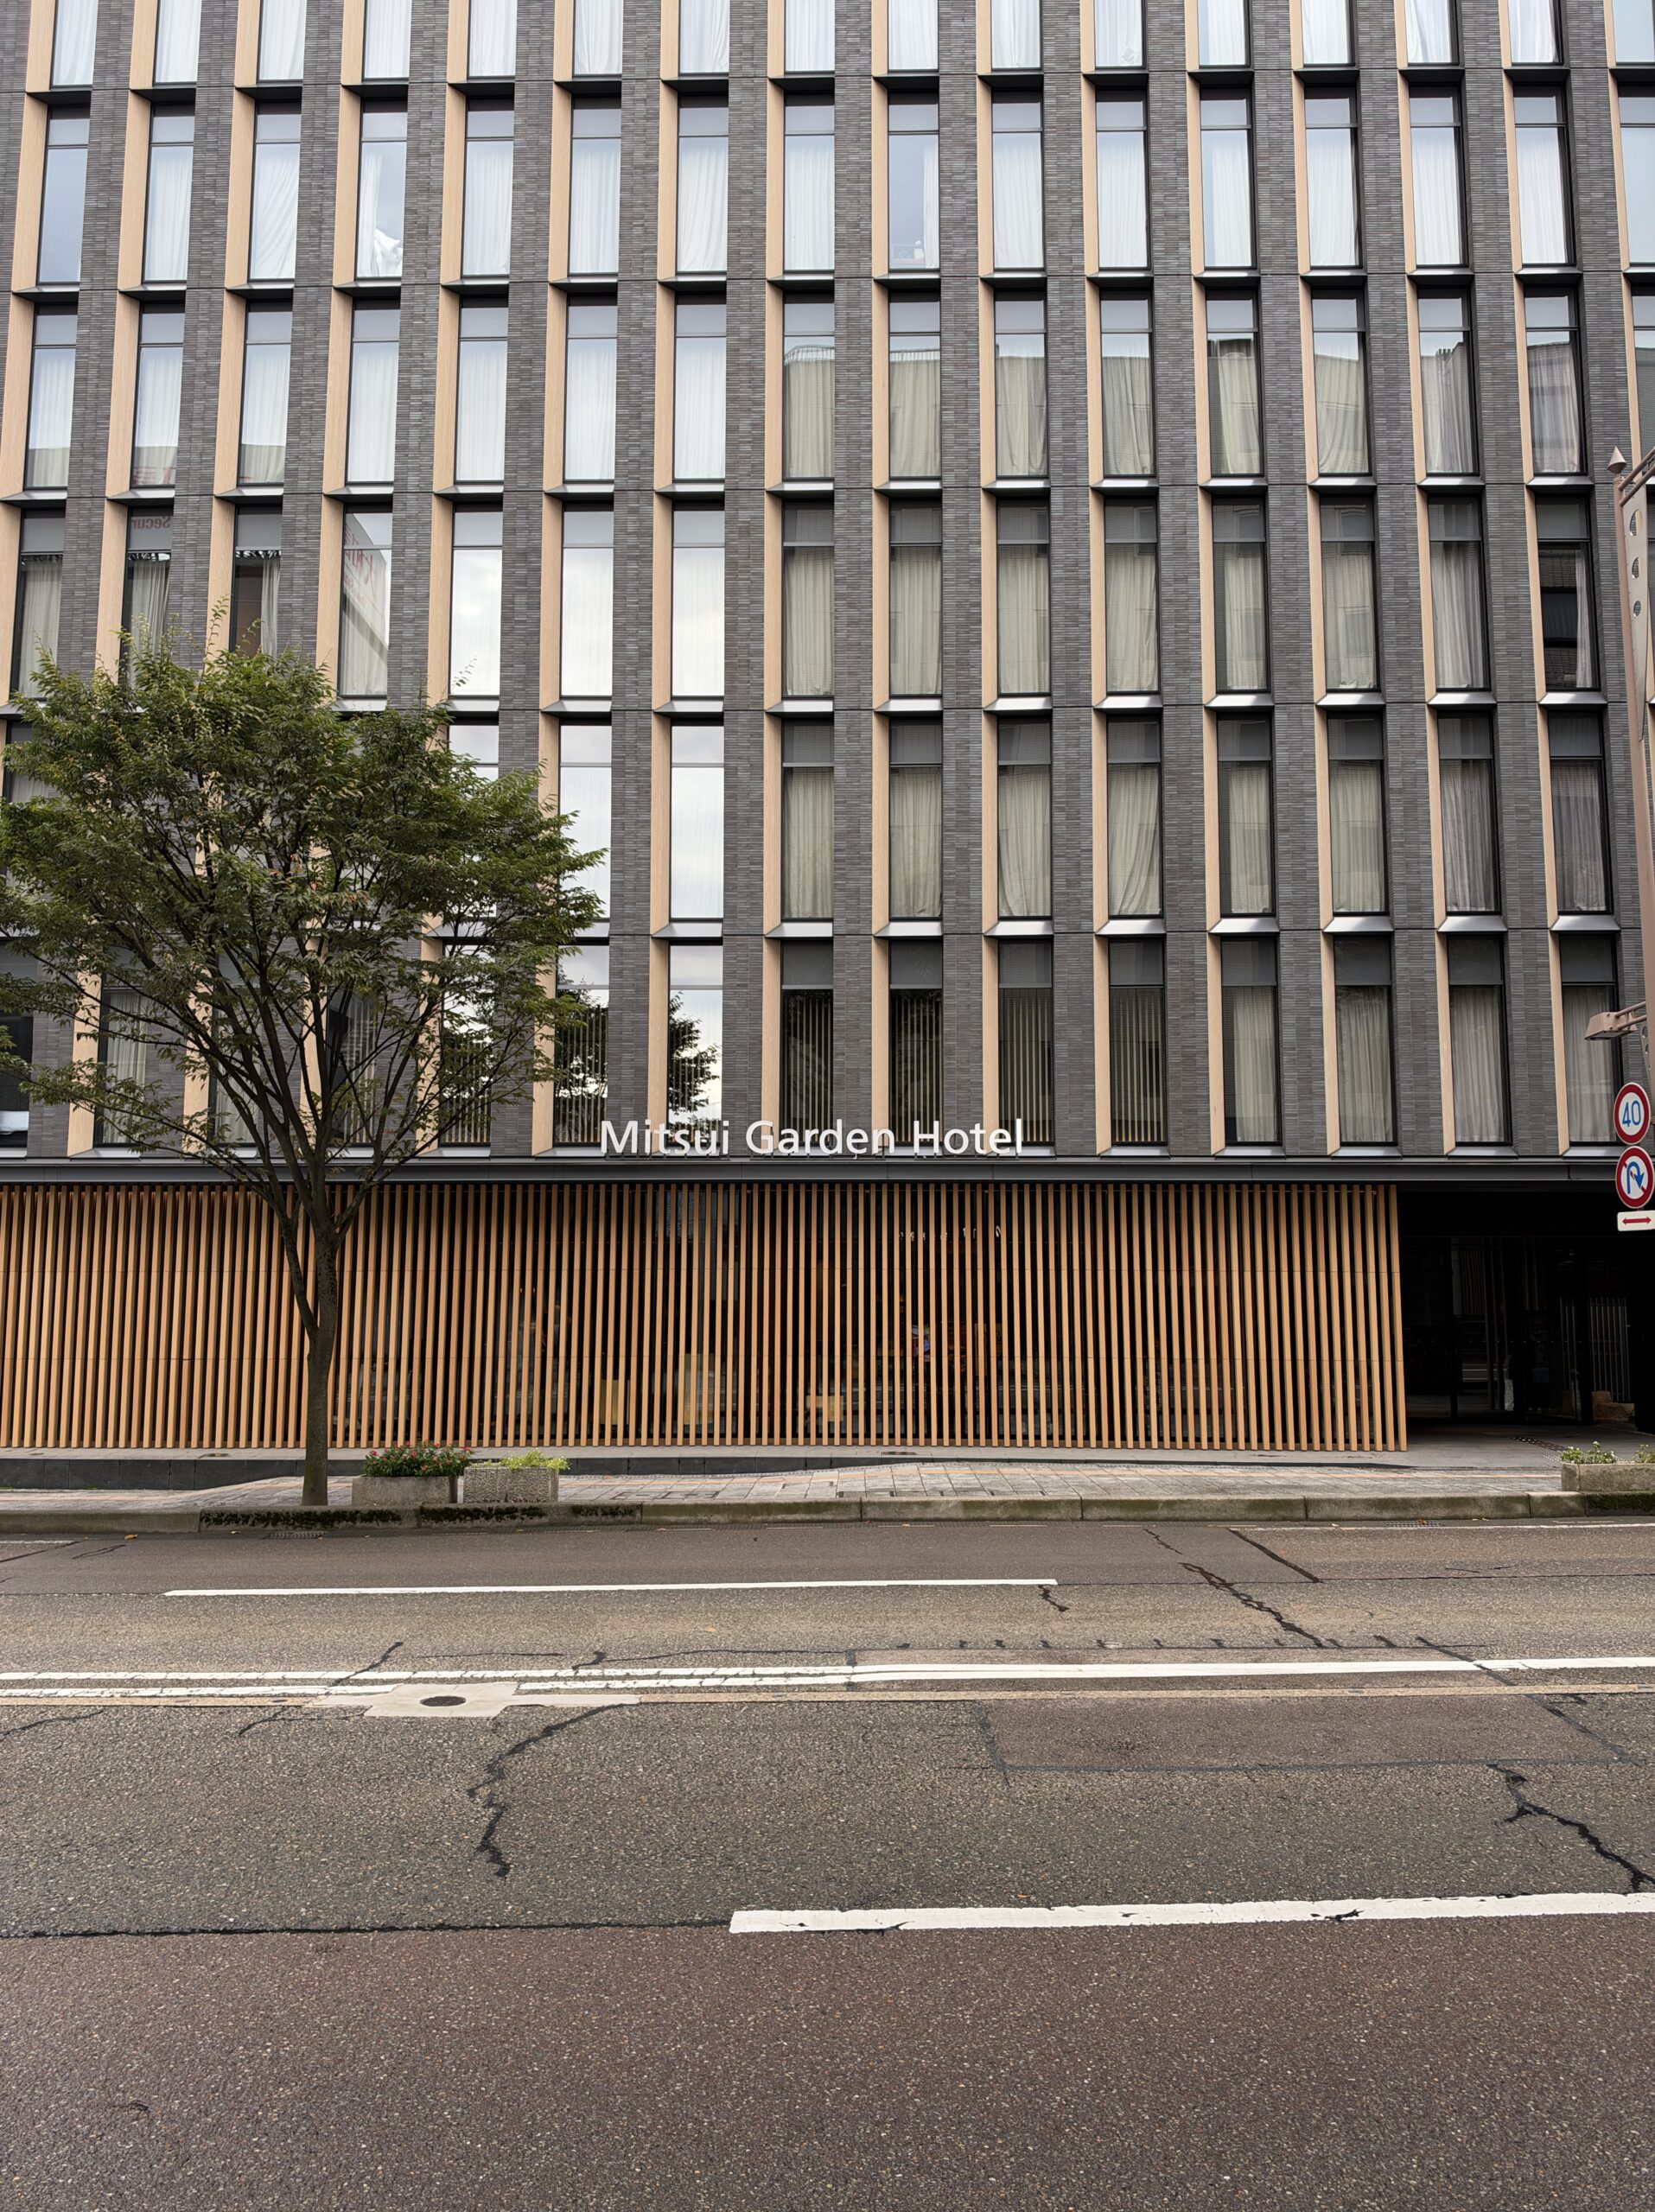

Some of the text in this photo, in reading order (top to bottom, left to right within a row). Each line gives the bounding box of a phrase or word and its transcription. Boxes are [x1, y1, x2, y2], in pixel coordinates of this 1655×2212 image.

[1622, 1100, 1641, 1127] 40
[601, 1118, 1022, 1155] Mitsui Garden Hotel
